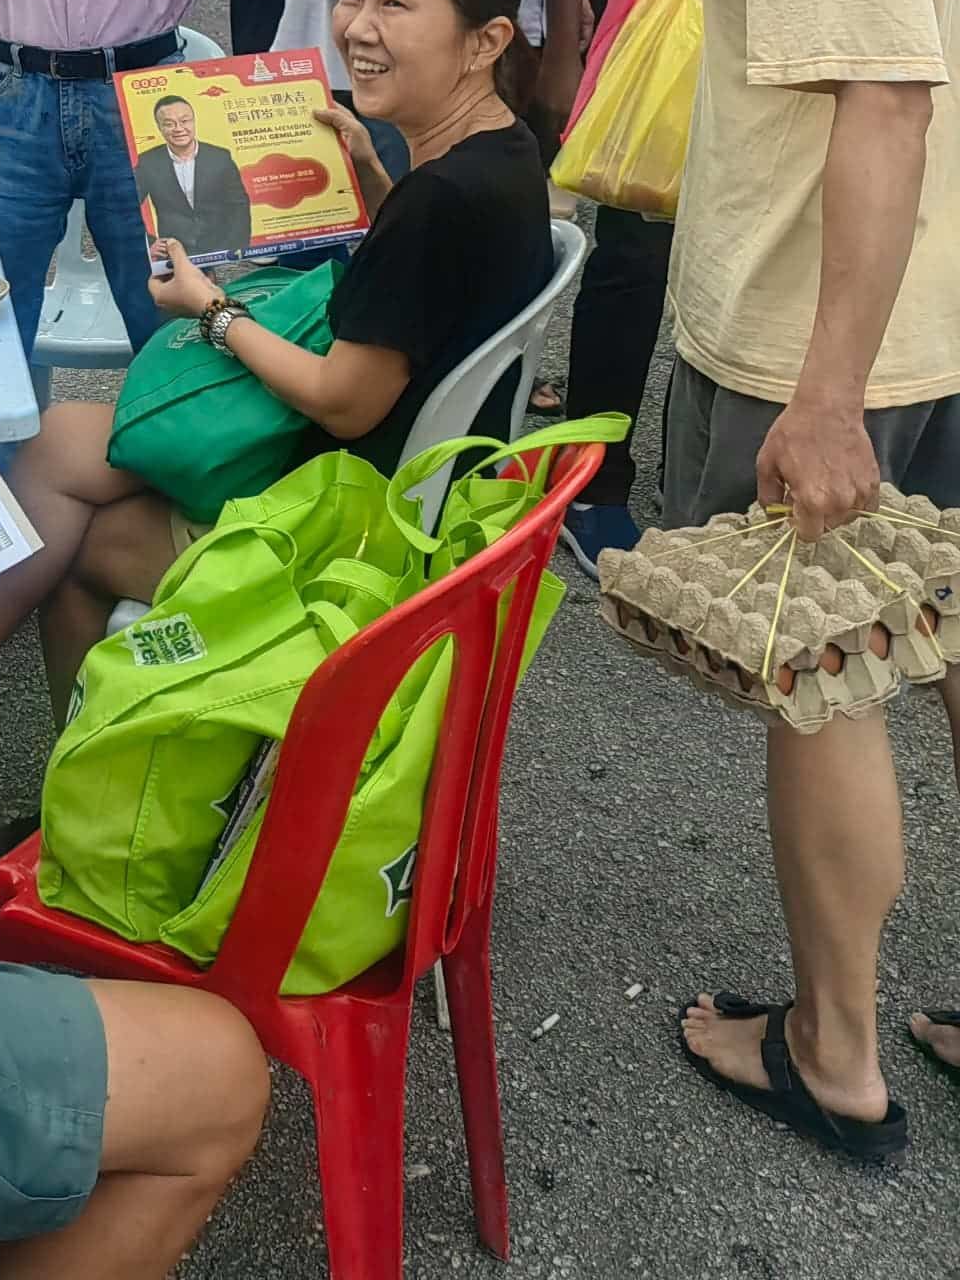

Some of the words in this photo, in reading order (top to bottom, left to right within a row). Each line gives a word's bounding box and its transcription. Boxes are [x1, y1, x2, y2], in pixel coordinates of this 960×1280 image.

[232, 127, 273, 137] BERSAMA
[274, 123, 313, 131] MEMBINA
[244, 245, 278, 257] JANUARY
